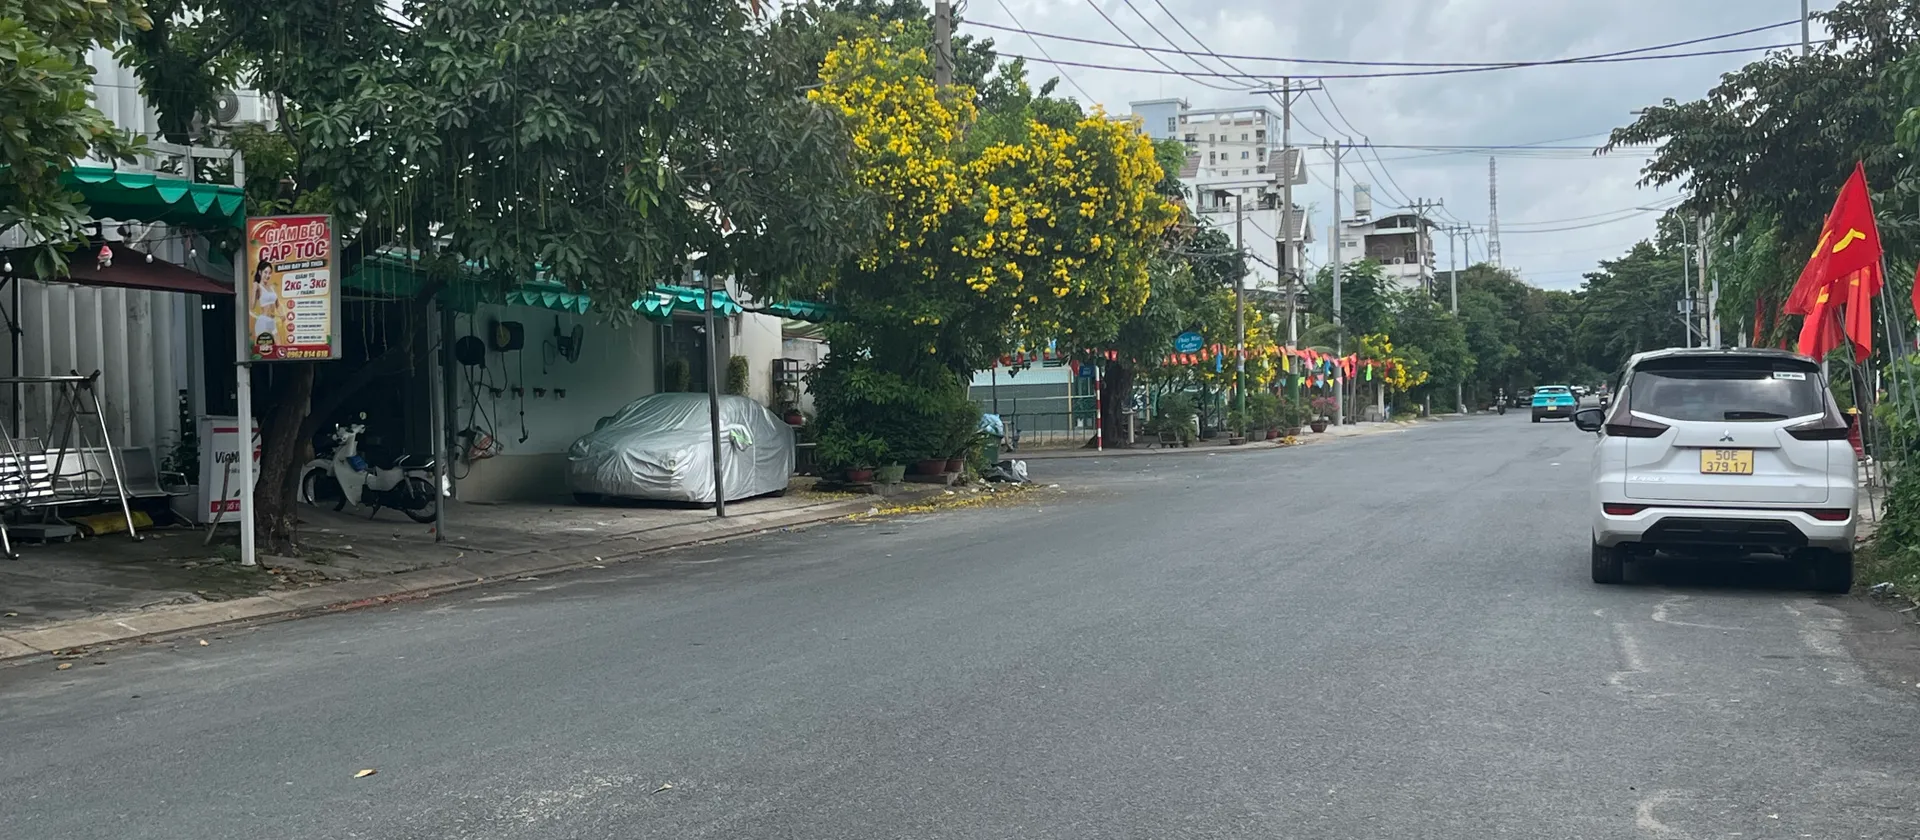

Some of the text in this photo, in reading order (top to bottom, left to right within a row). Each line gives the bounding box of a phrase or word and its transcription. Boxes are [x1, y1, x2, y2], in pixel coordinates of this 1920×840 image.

[266, 221, 324, 243] GIẢM BÉO
[294, 237, 328, 259] TỐC
[284, 280, 301, 291] 2KG
[309, 278, 327, 289] 3KG
[1715, 450, 1738, 461] 50E
[1706, 461, 1747, 473] 379.17
